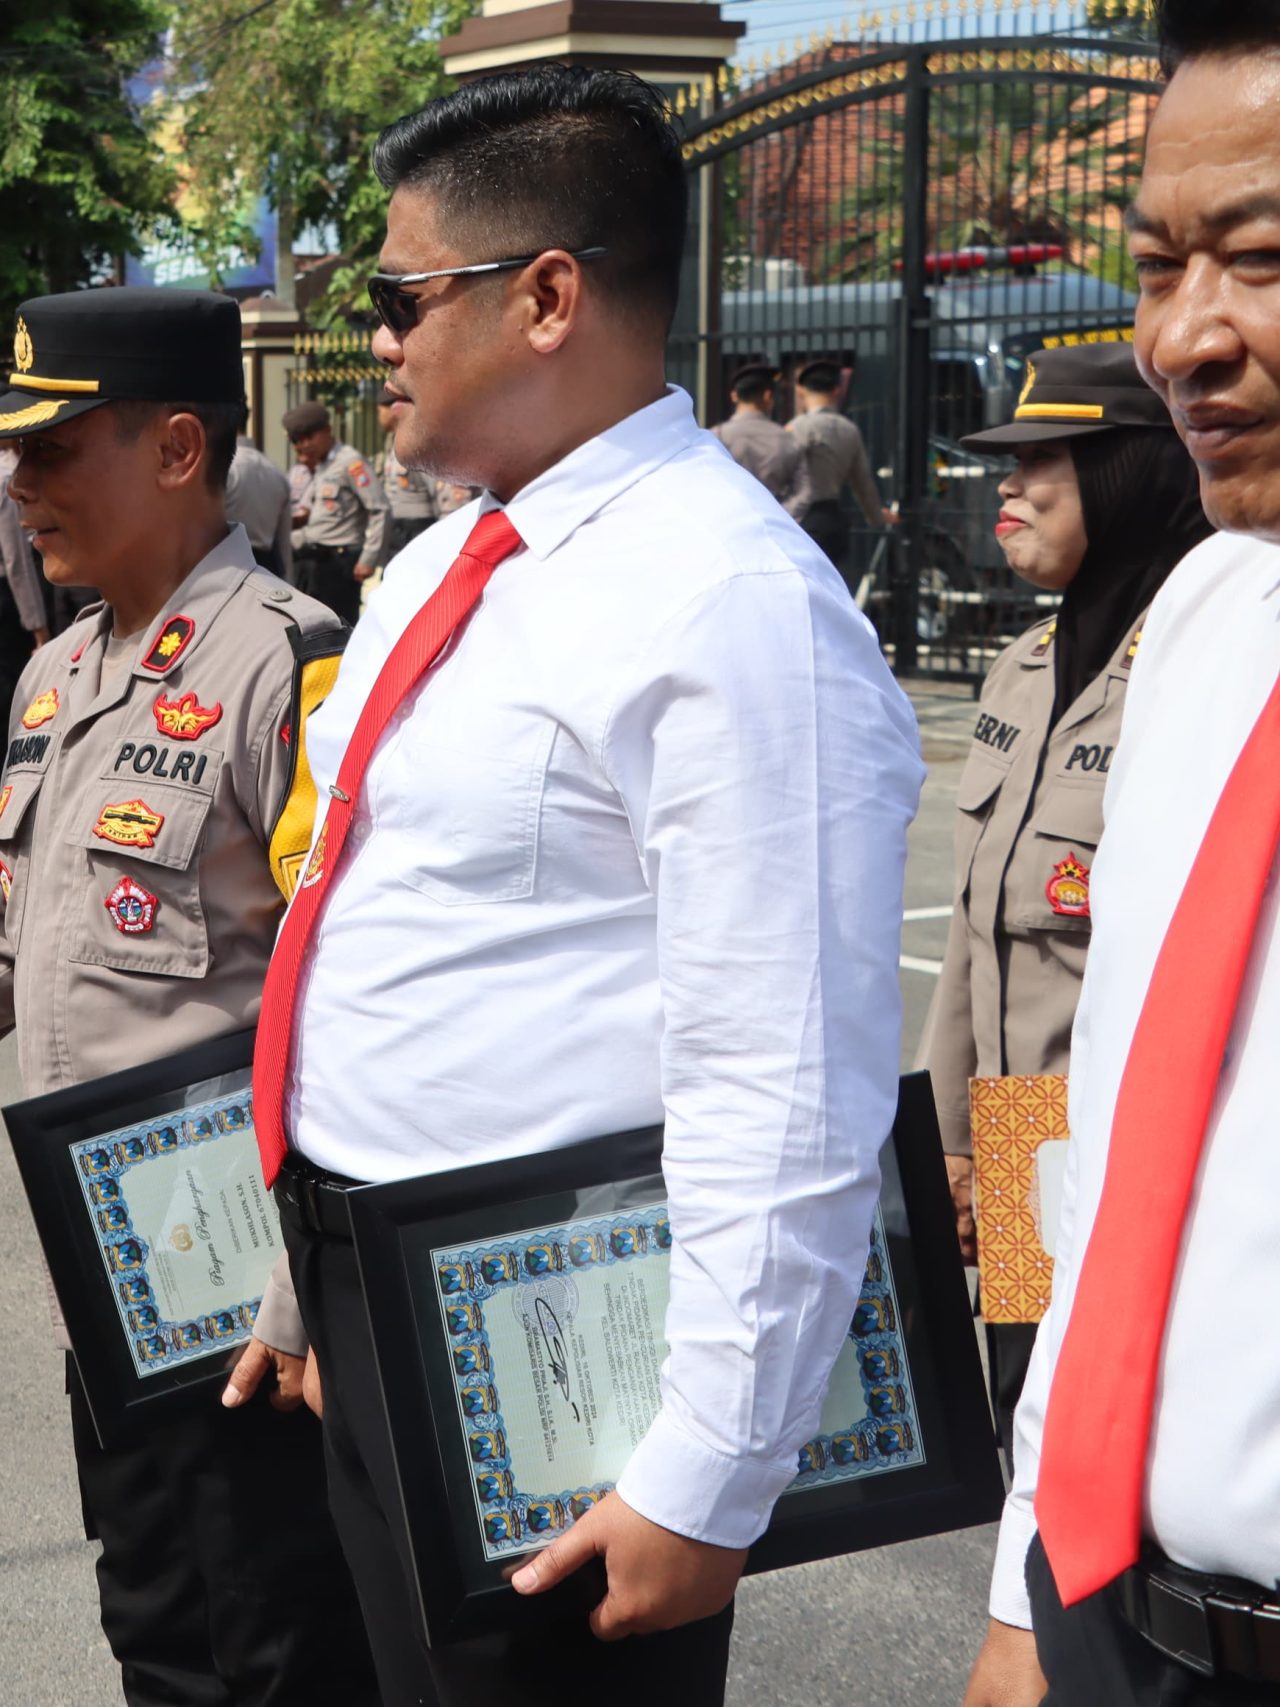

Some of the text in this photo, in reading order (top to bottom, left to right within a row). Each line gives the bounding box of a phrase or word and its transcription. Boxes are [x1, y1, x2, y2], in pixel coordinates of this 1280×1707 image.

[973, 712, 1021, 752] ERNI
[113, 742, 208, 785] POLRI
[185, 1169, 225, 1287] Piagam Penghargaan
[239, 1197, 260, 1248] MUKHLASON,
[247, 1174, 274, 1247] KOMPOL 67040111
[603, 1282, 615, 1322] SEHINGGA
[583, 1370, 594, 1402] OKTOBER
[611, 1378, 621, 1399] KOTA
[638, 1380, 647, 1401] KOTA
[582, 1403, 591, 1426] KEDIRI
[587, 1427, 595, 1446] KOTA
